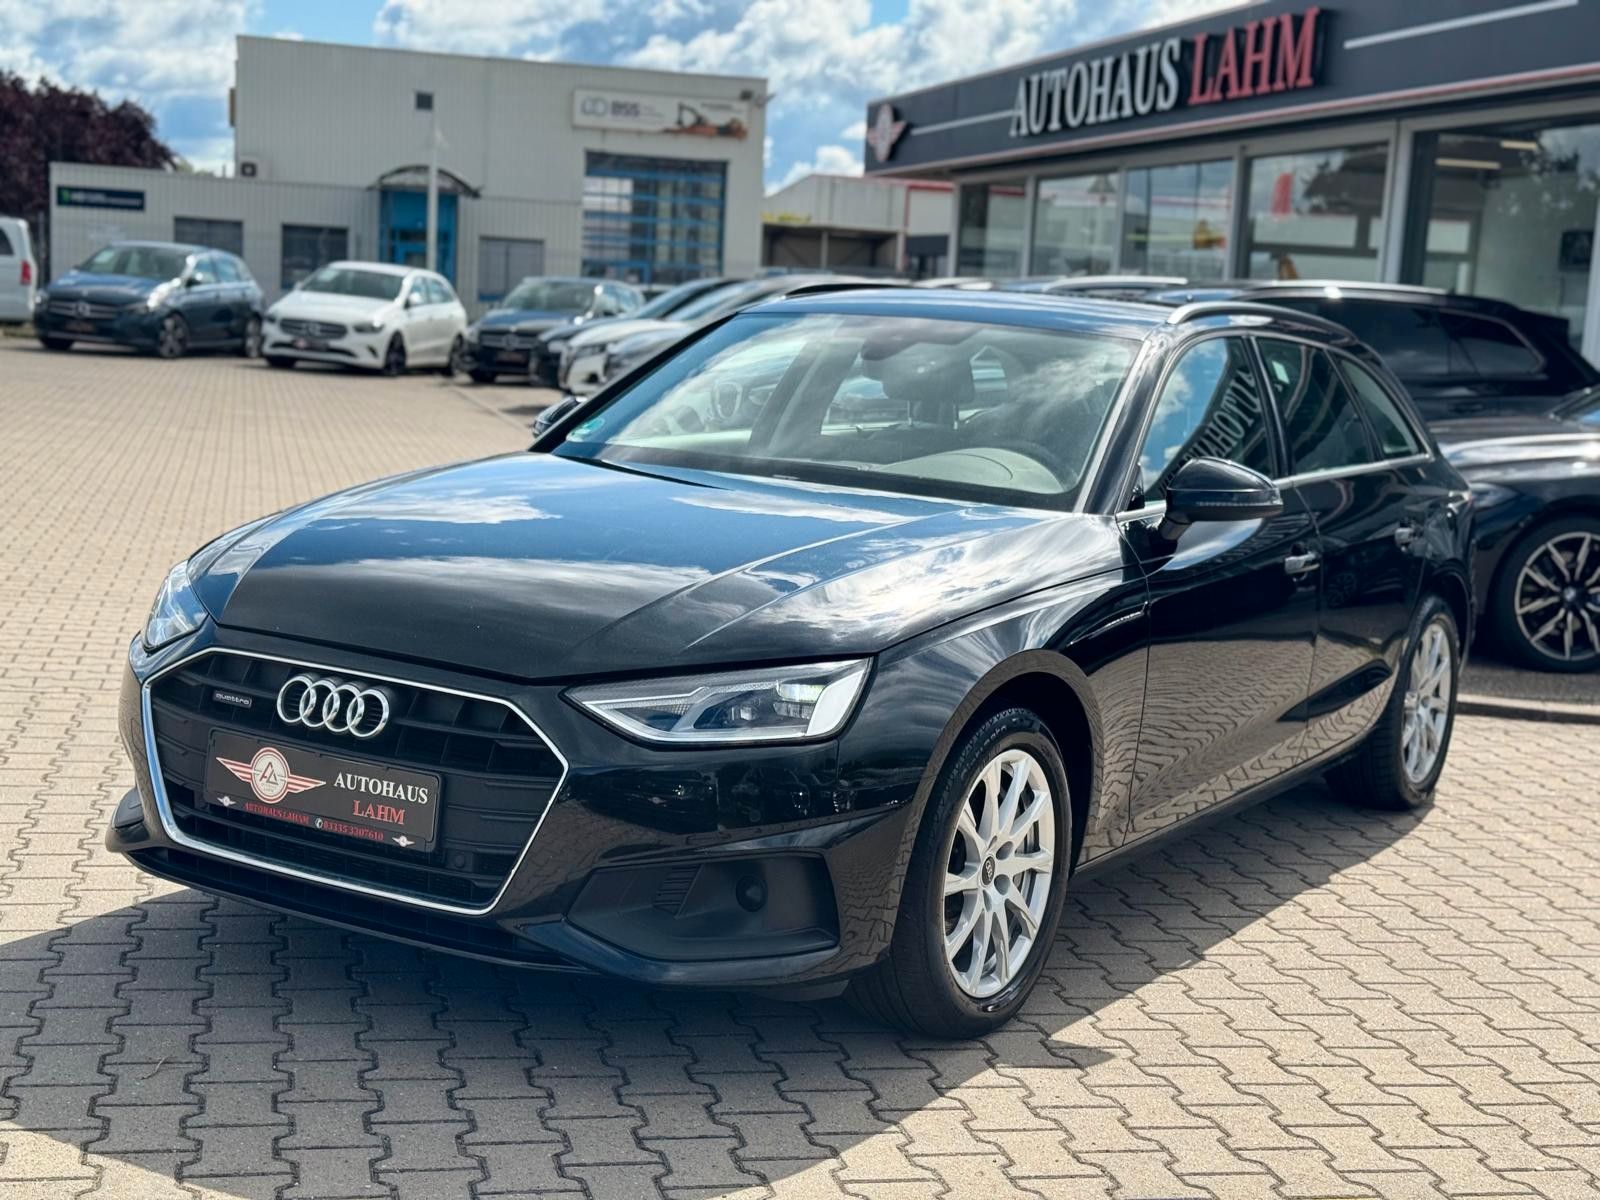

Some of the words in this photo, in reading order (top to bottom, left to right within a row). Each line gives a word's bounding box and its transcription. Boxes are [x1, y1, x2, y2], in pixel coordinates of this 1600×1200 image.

[1009, 37, 1181, 137] AUTOHAUS
[1187, 6, 1320, 106] LAHM
[215, 692, 250, 705] quattro
[333, 772, 428, 805] AUTOHAUS
[353, 799, 405, 825] LAHM
